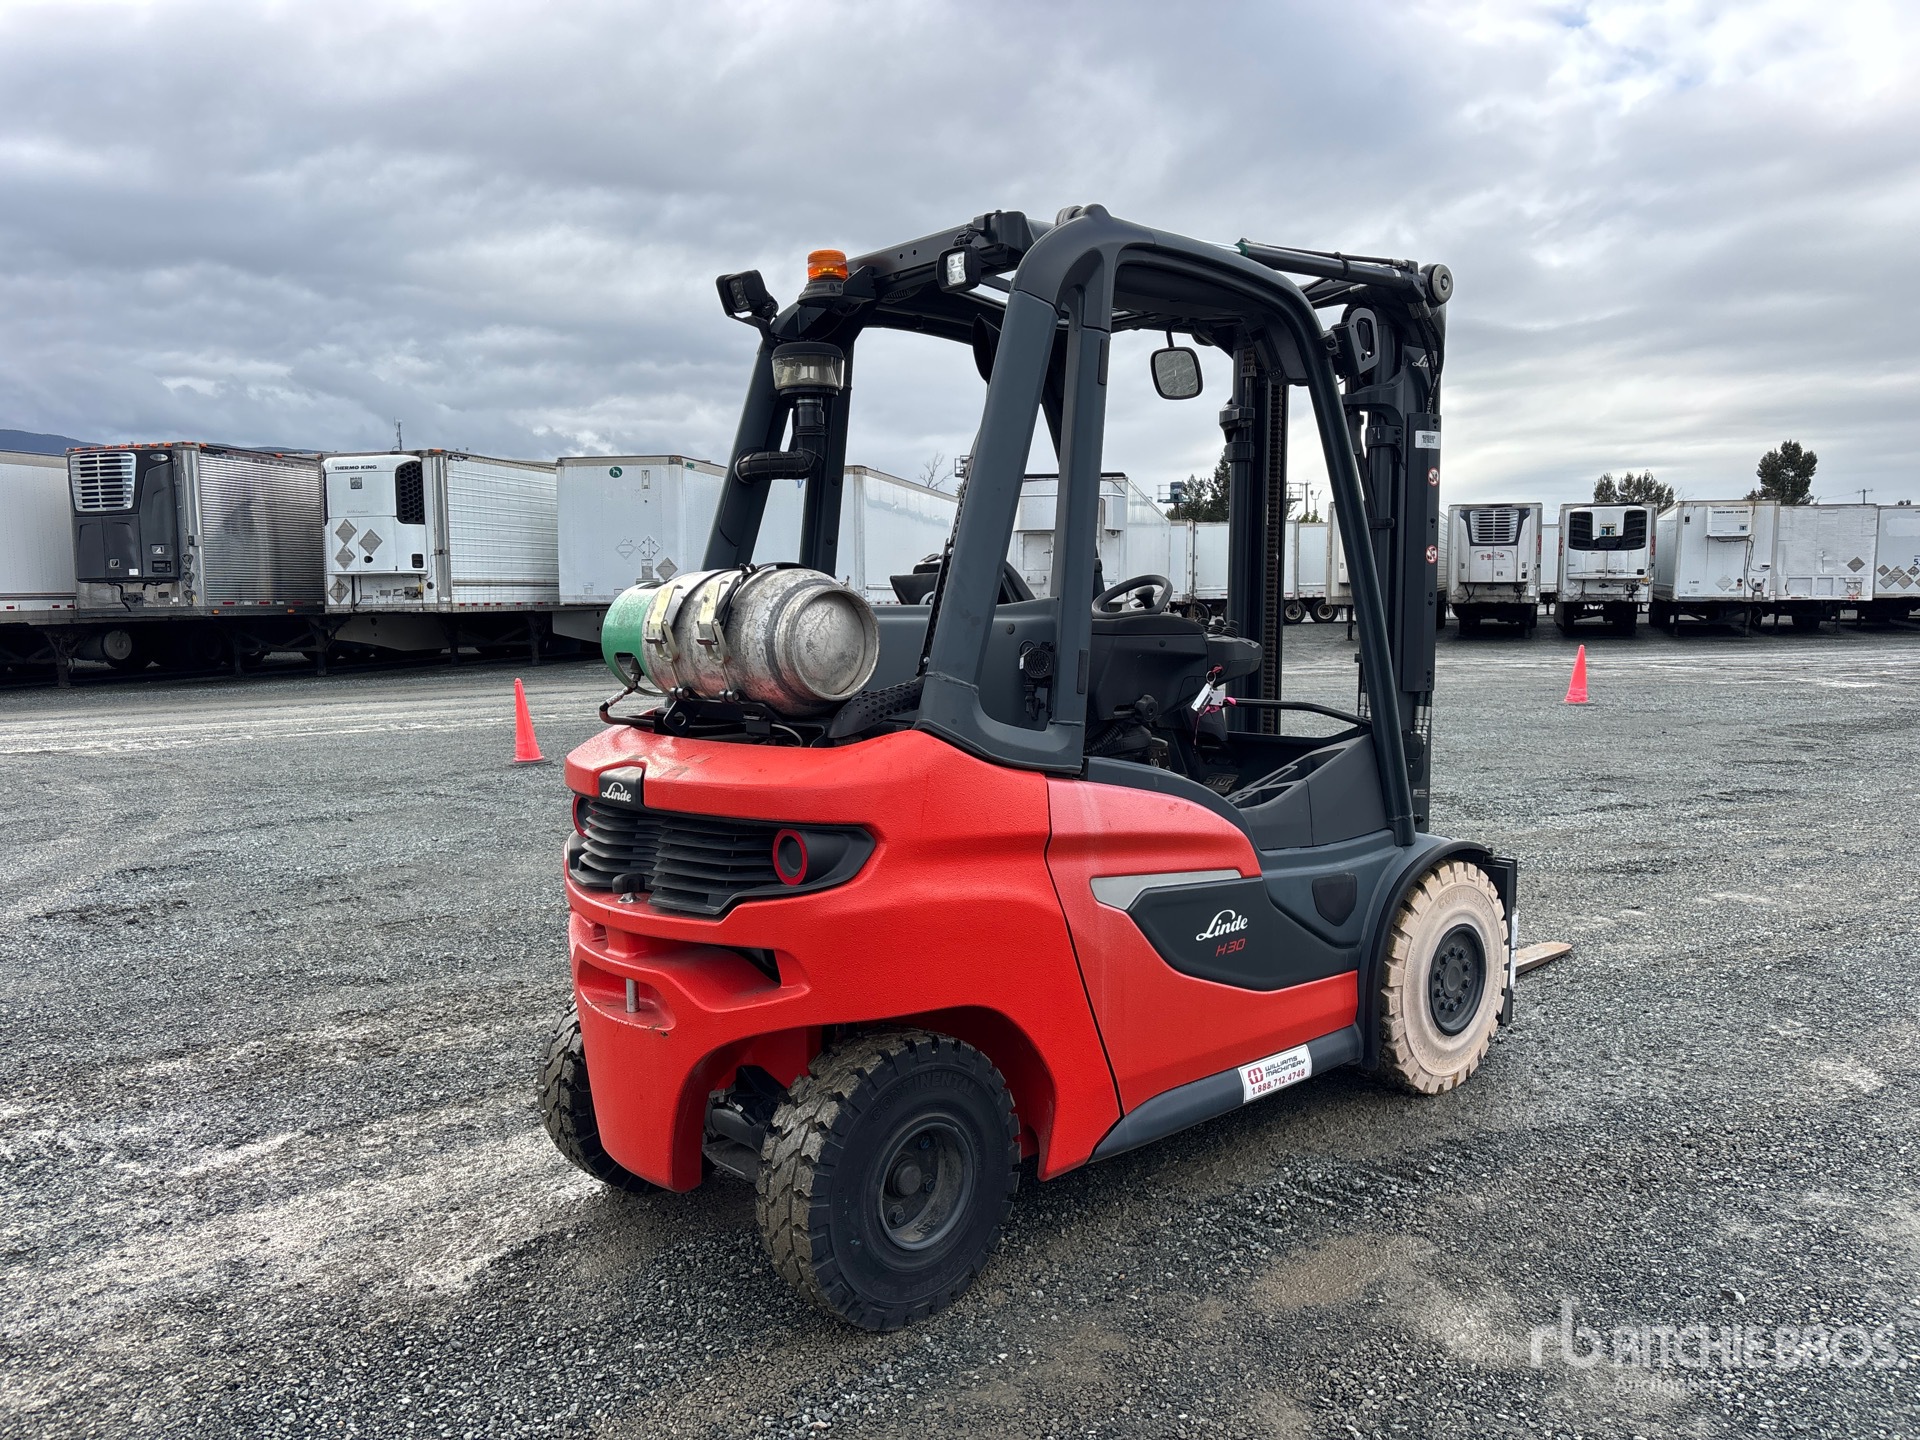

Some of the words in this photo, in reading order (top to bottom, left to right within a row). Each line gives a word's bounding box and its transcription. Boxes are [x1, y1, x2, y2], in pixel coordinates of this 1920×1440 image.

[601, 781, 632, 802] Linde
[1195, 909, 1248, 941] Linde
[1215, 938, 1246, 957] H30
[1264, 1055, 1298, 1072] WILLIAMS
[1265, 1058, 1306, 1078] MACHINERY
[1251, 1068, 1306, 1095] 1.888.712.4748
[869, 1072, 978, 1123] CONTINENTAL
